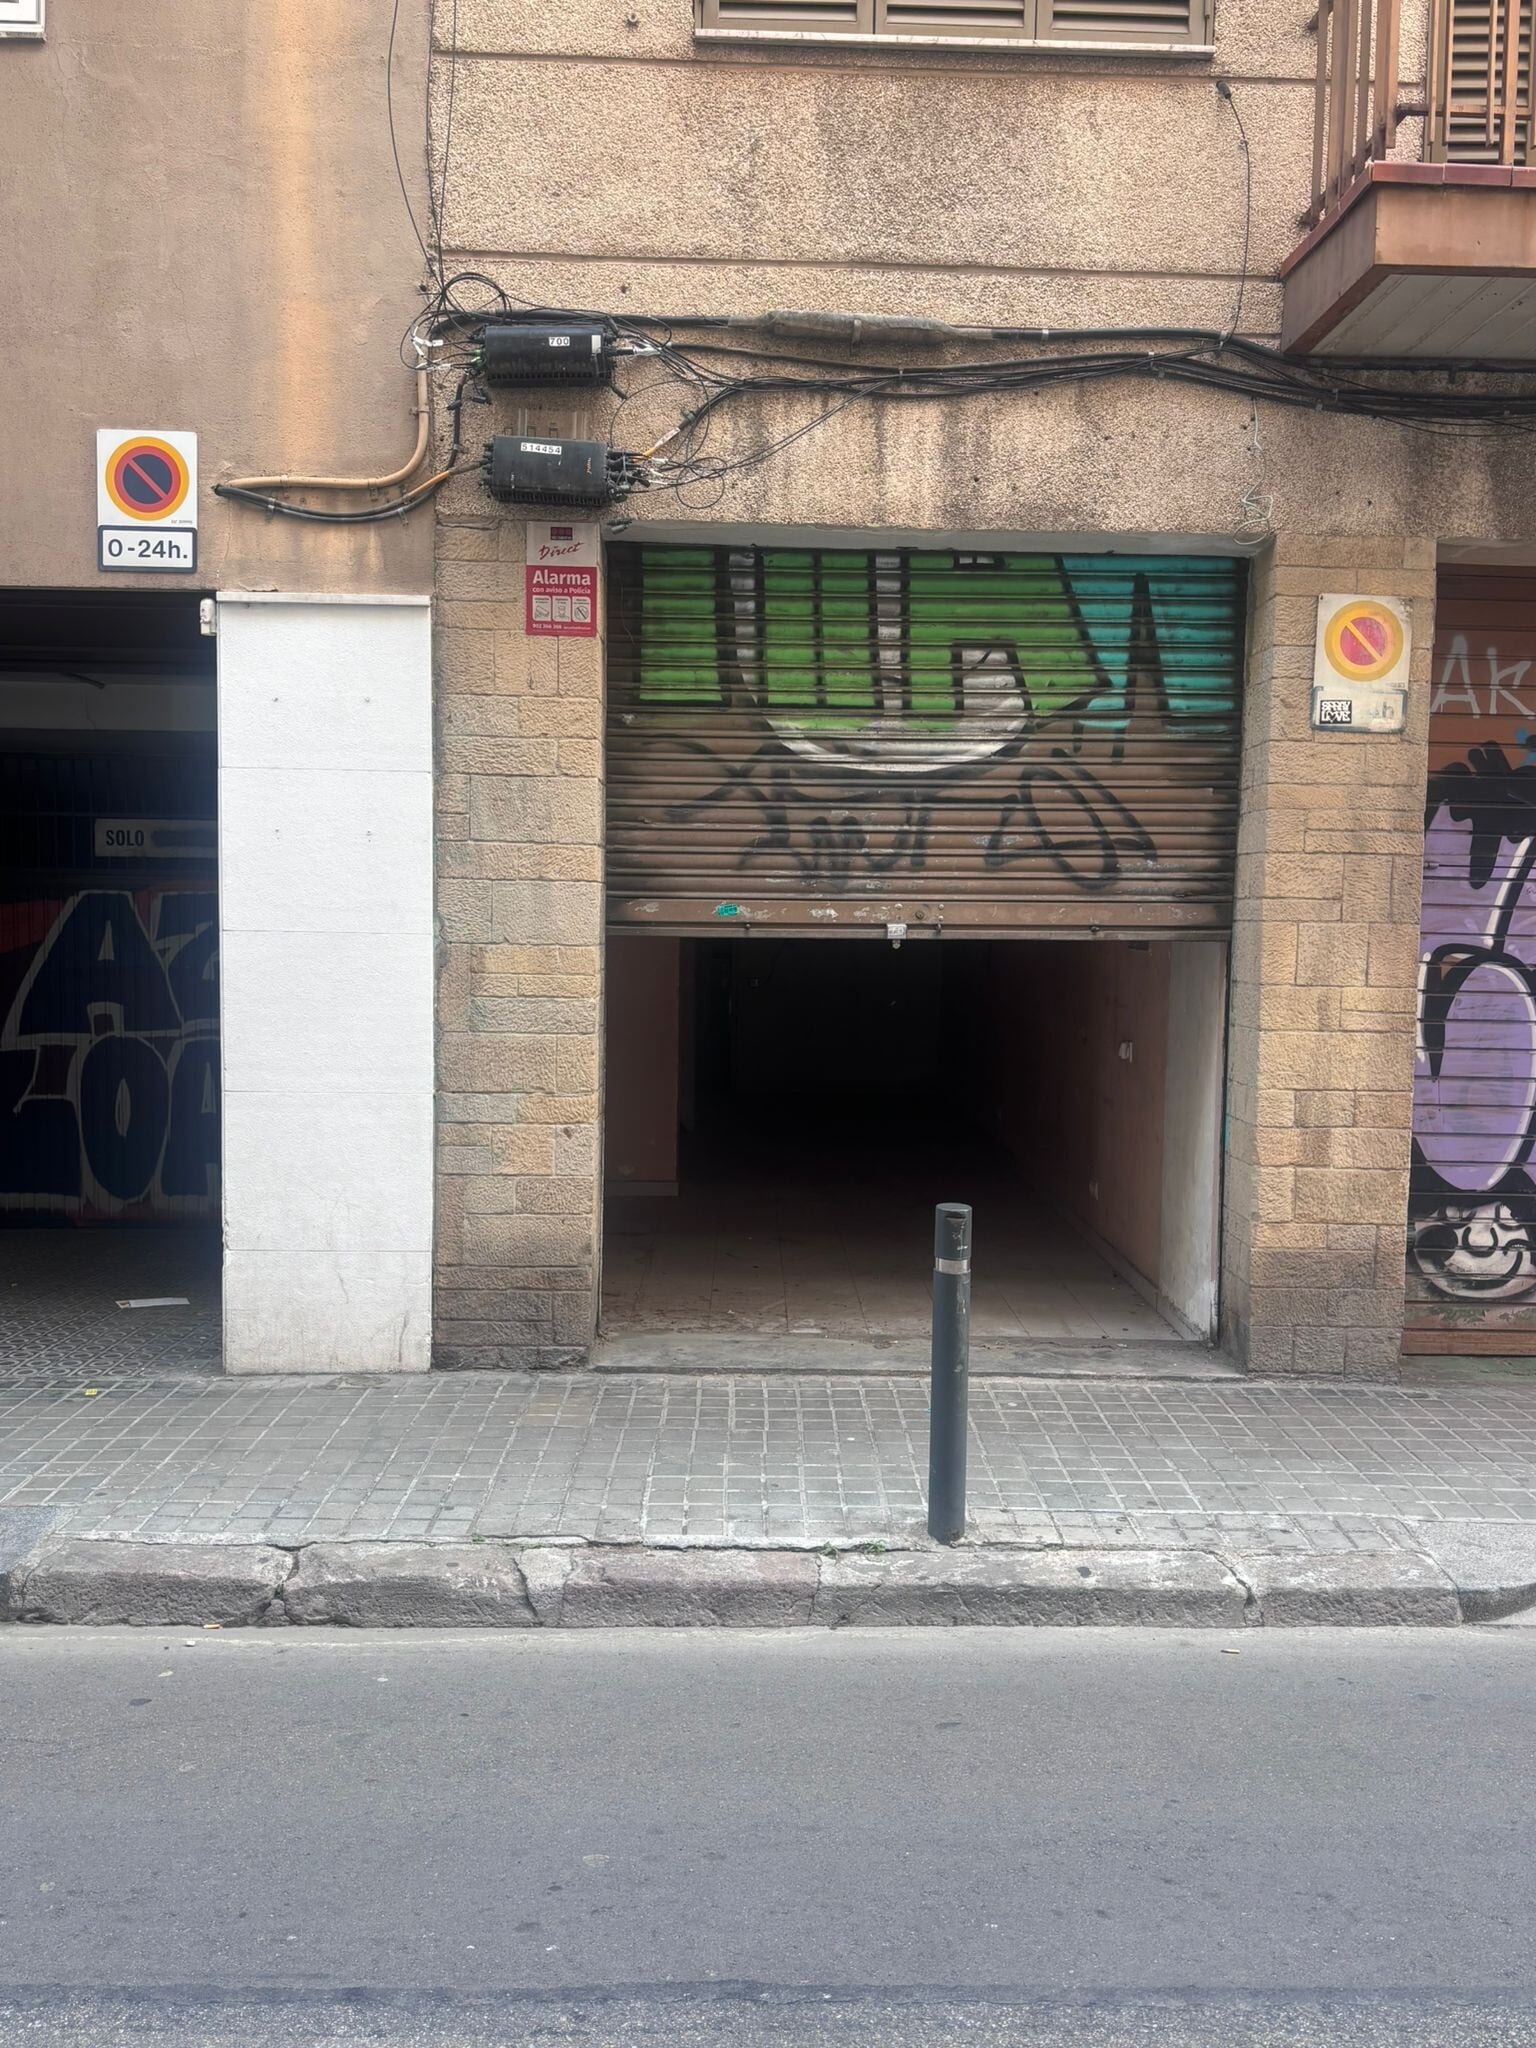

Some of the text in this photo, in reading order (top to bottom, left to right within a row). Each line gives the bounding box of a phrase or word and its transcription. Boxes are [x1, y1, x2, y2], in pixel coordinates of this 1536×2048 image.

[550, 337, 570, 346] 700
[521, 443, 561, 454] 514454
[539, 542, 584, 560] Direct
[533, 569, 591, 585] Alarma
[105, 829, 145, 846] SOLO
